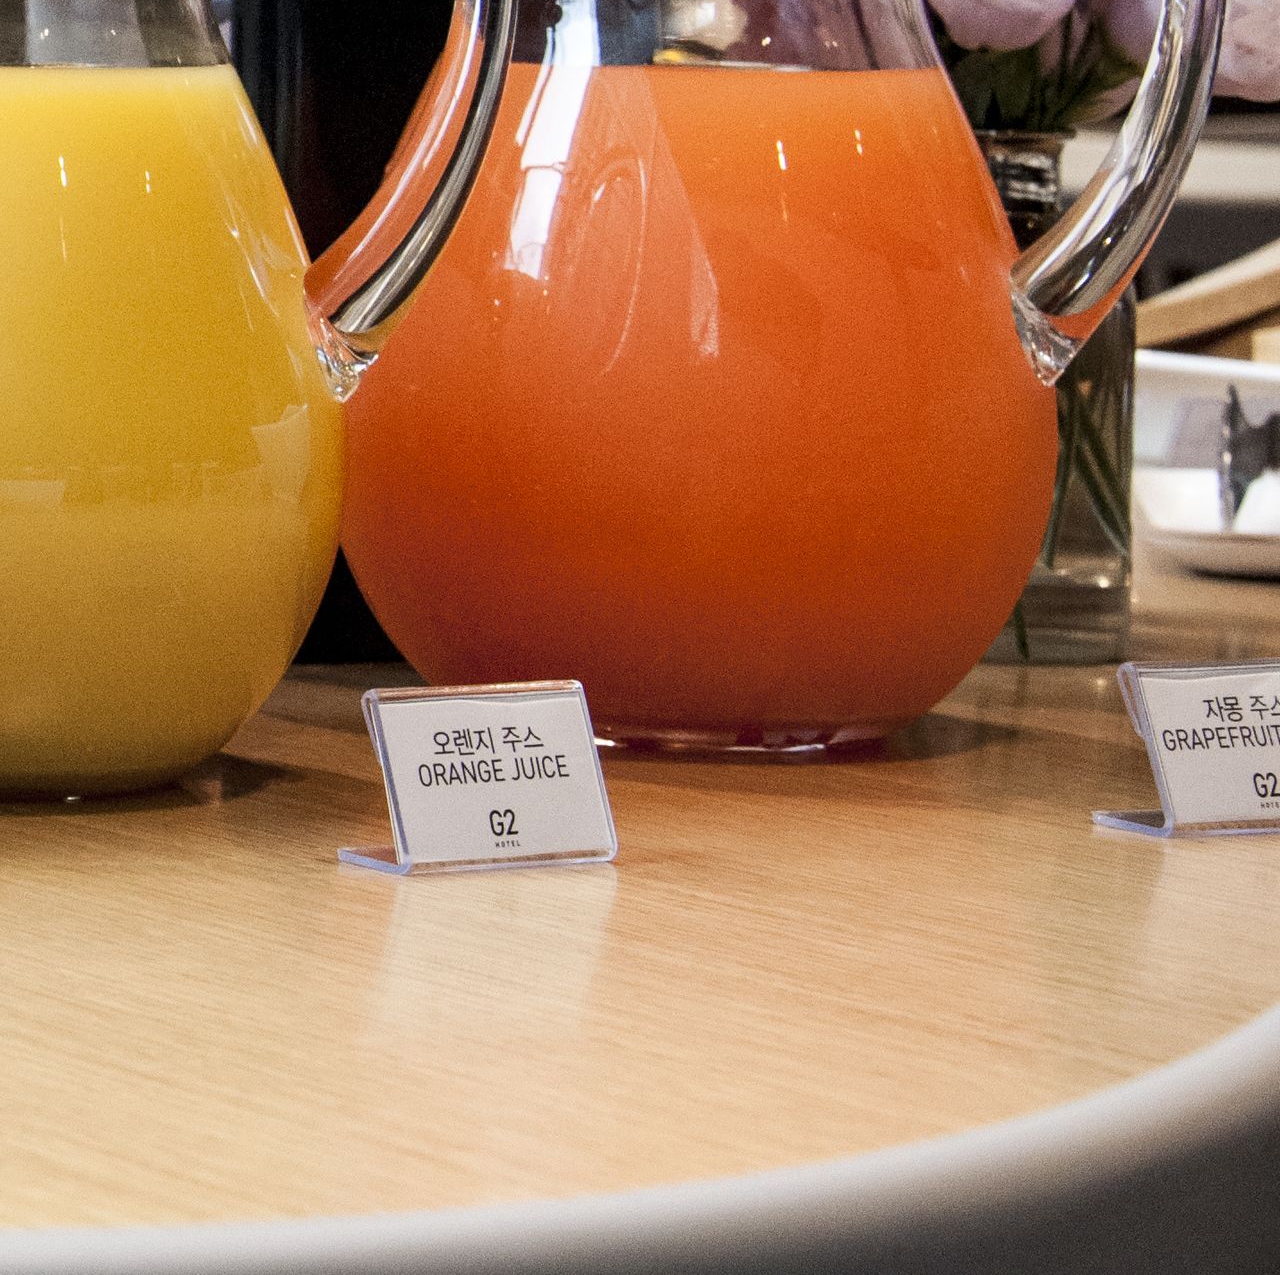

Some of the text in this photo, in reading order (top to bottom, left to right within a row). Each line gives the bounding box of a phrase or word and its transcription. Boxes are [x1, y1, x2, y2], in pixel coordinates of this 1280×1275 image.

[1202, 696, 1243, 722] 자몽
[433, 726, 544, 756] 오렌지 주스
[418, 755, 570, 787] ORANGE JUICE
[1253, 772, 1280, 798] G2
[489, 809, 519, 836] G2
[495, 840, 521, 848] HOTEL
